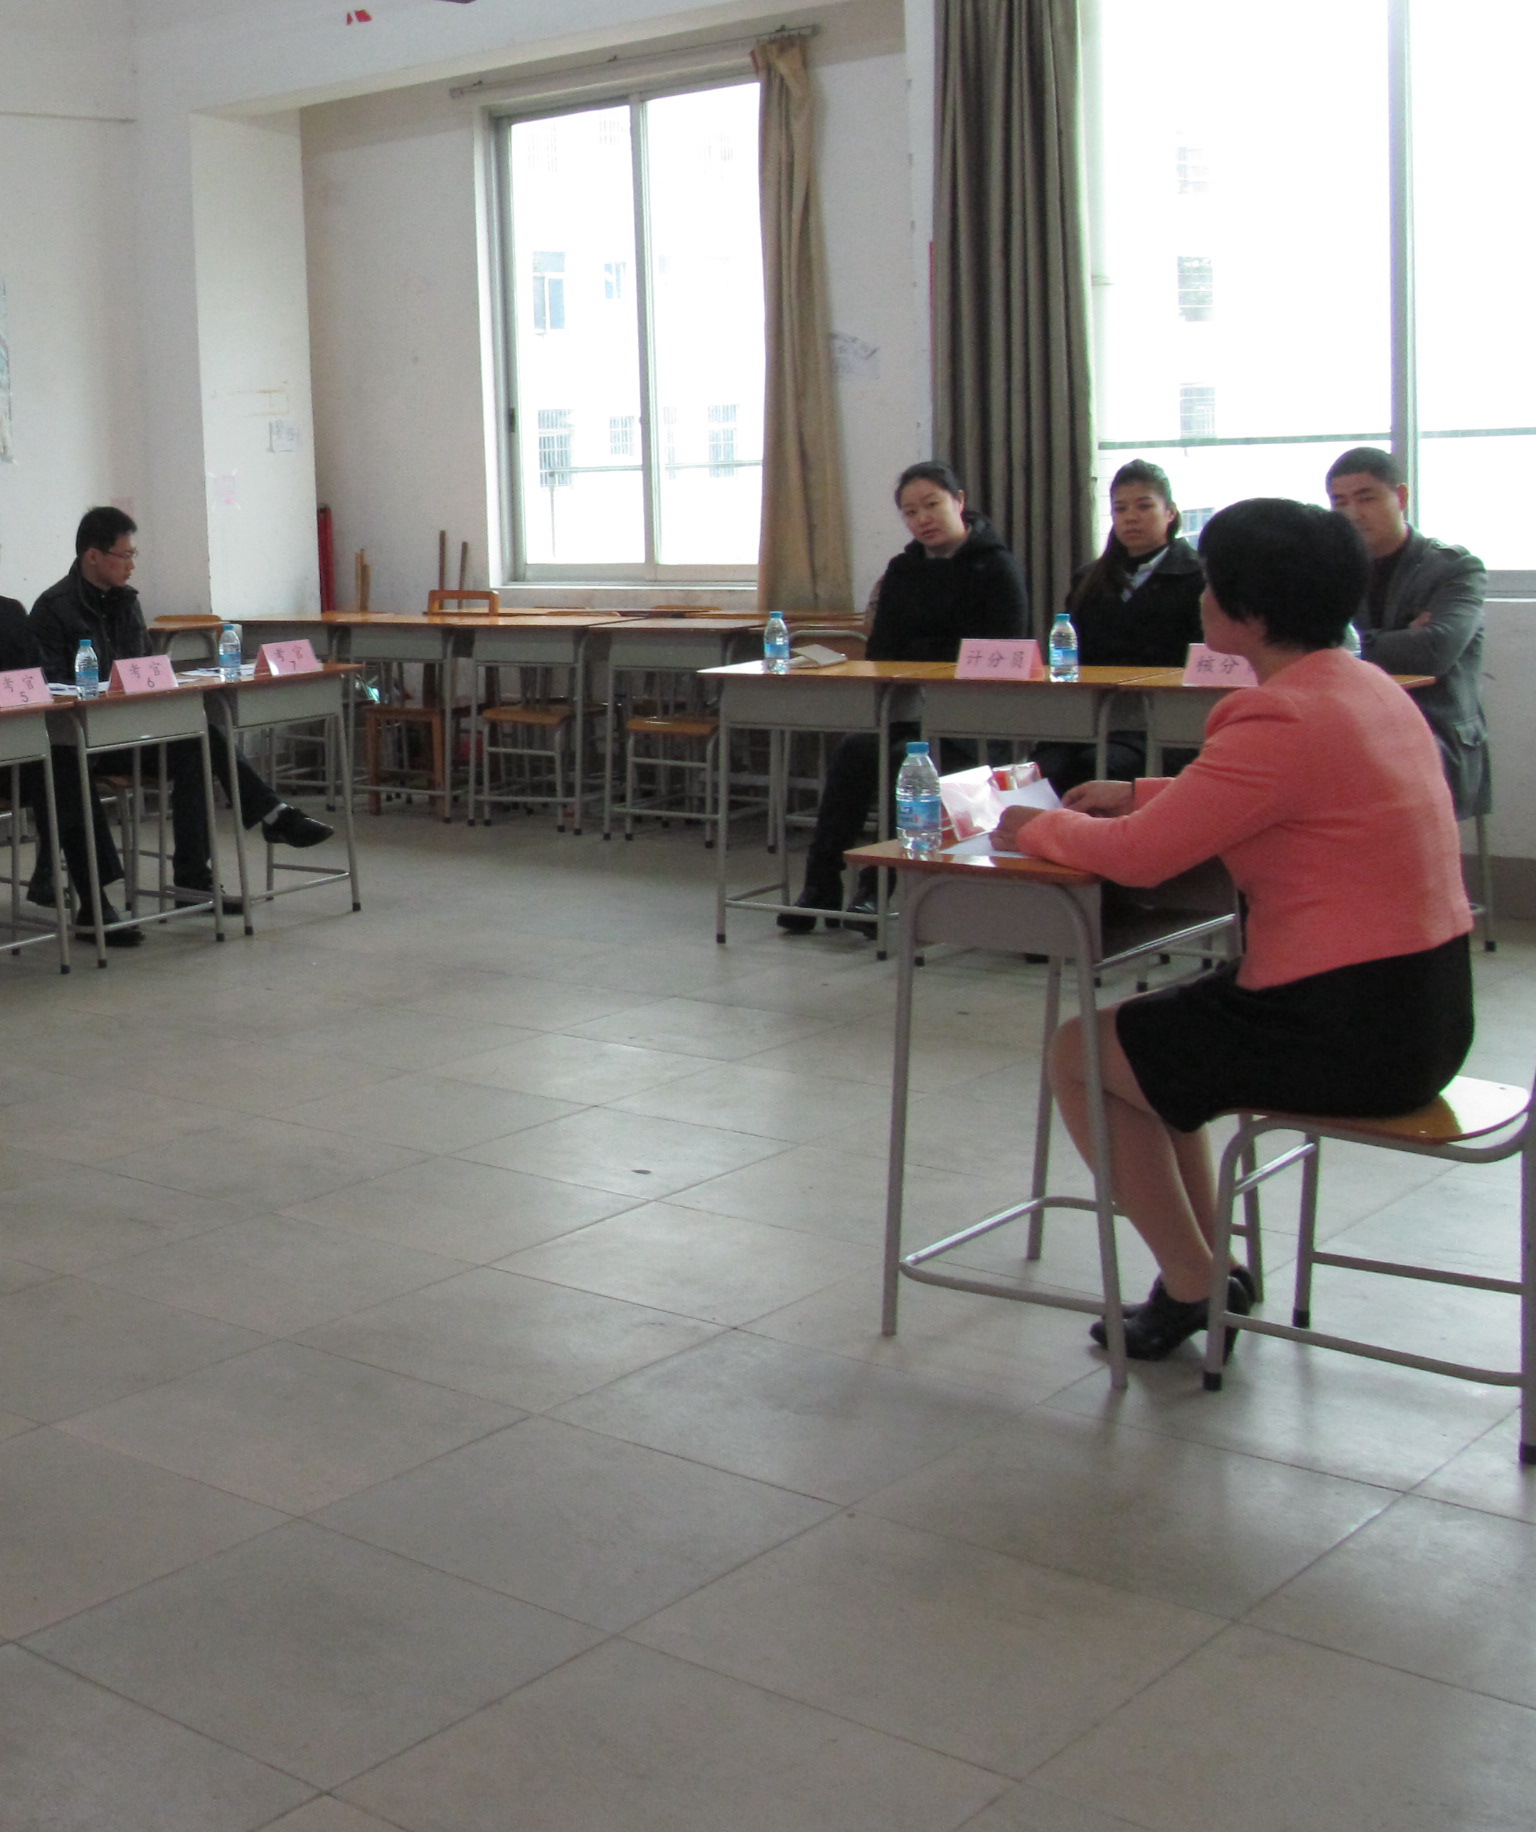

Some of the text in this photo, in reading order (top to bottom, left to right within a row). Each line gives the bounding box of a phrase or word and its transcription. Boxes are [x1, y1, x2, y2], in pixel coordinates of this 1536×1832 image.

[274, 645, 304, 662] 考官
[964, 648, 1026, 671] 计分员
[128, 661, 162, 680] 考官
[288, 660, 297, 671] 7
[1196, 653, 1255, 675] 核分
[2, 674, 35, 693] 考官
[146, 676, 156, 688] 6
[19, 691, 29, 703] 5
